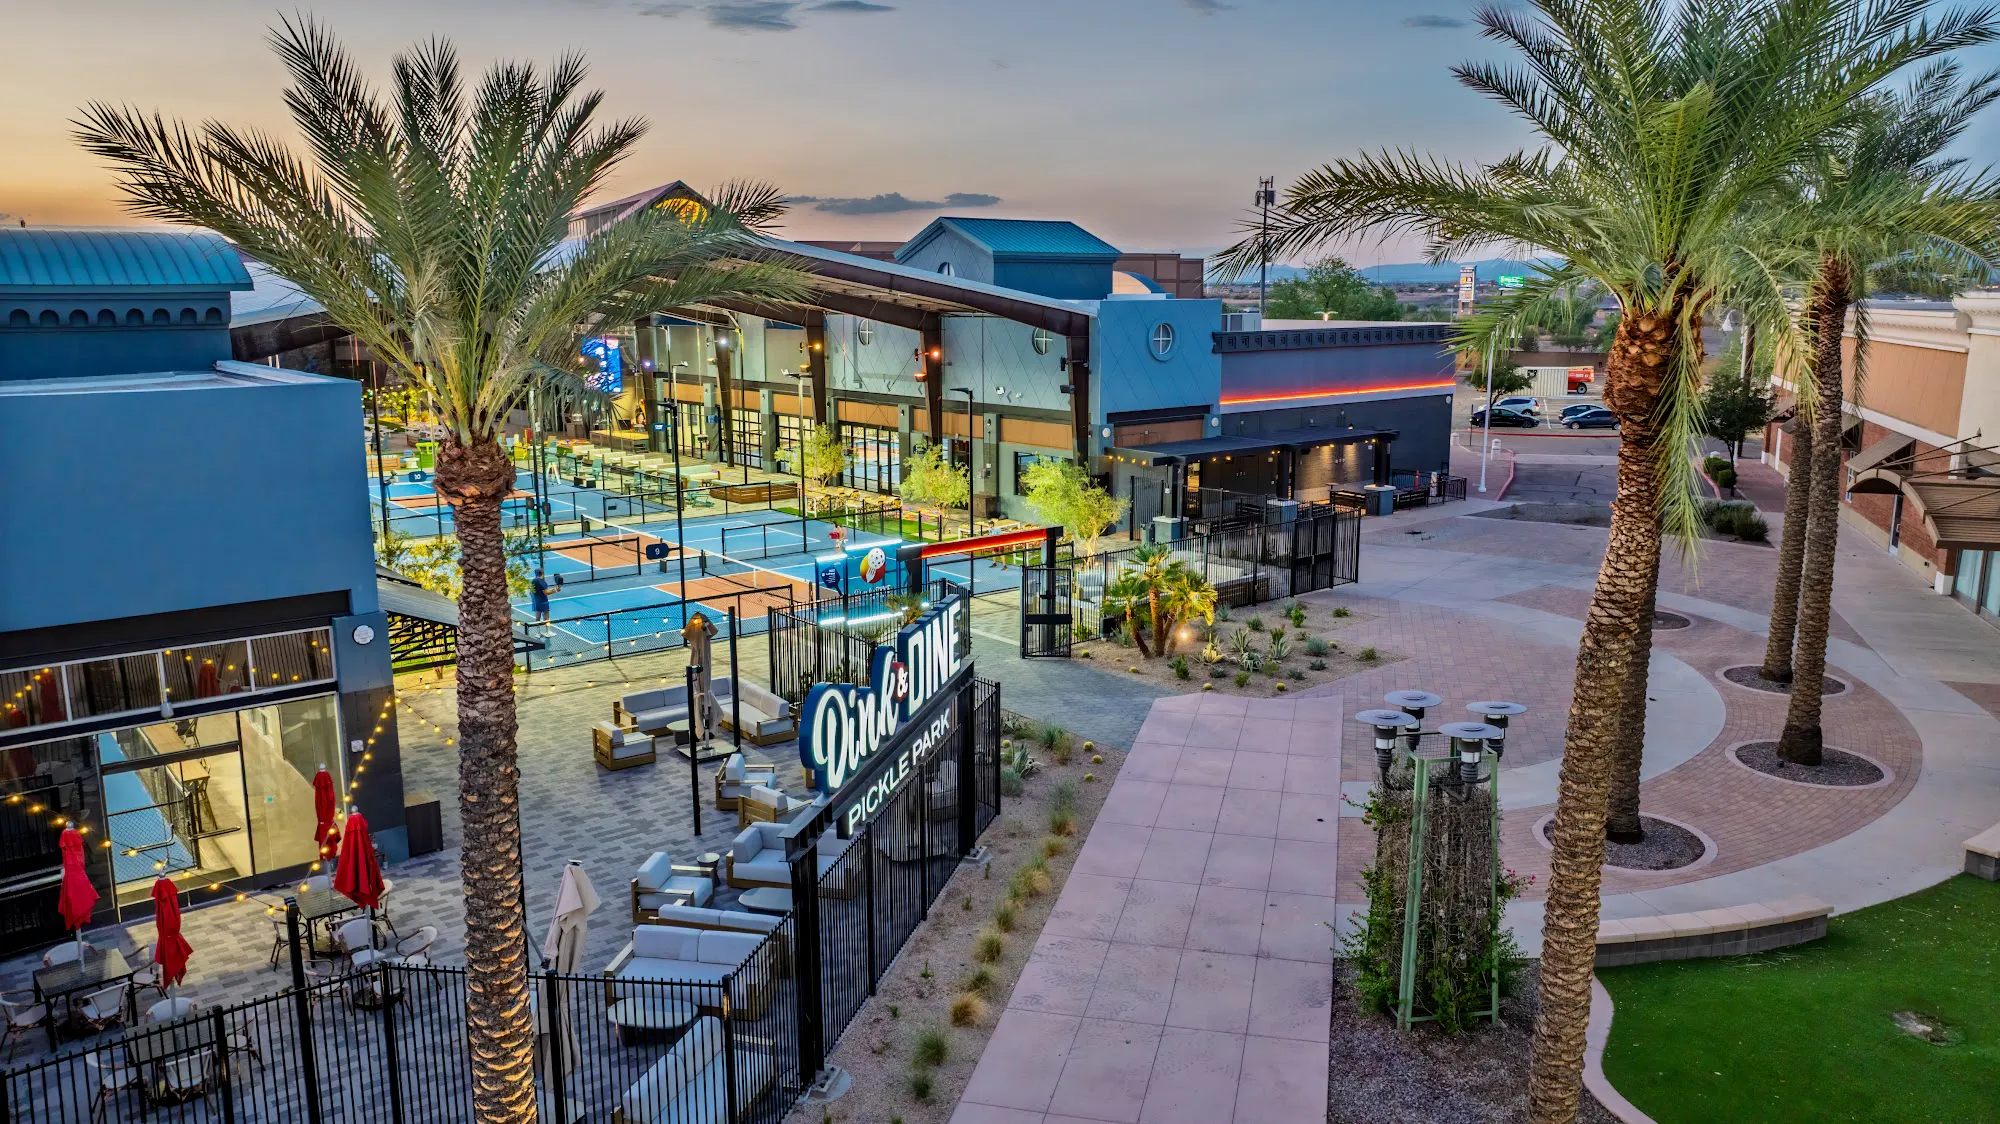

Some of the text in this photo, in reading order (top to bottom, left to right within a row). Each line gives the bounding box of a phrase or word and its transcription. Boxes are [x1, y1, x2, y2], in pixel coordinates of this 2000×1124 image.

[655, 547, 660, 555] 9
[812, 601, 961, 788] Dink & DINE
[848, 708, 950, 836] PICKLE PARK
